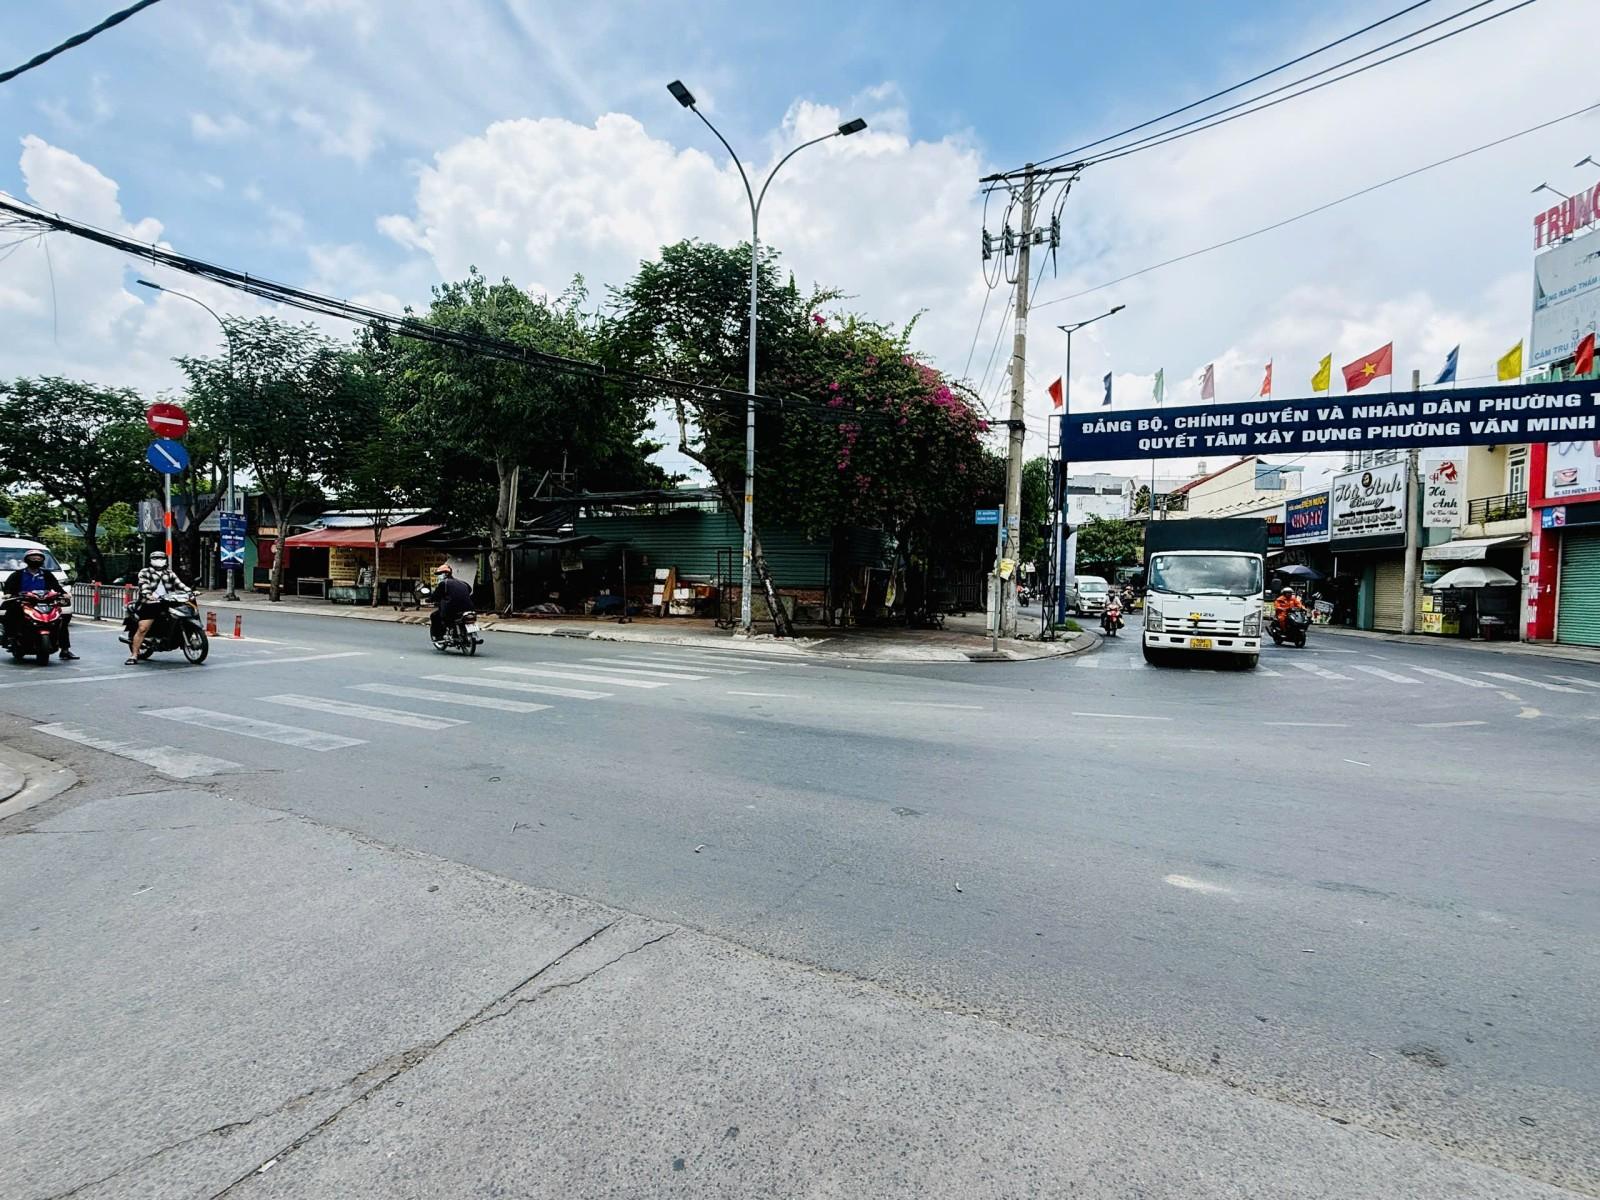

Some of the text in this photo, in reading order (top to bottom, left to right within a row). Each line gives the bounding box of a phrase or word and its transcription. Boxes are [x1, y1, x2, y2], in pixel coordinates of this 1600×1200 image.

[1082, 418, 1132, 434] ĐẢNG
[1138, 416, 1168, 432] BỘ,
[1174, 412, 1234, 429] CHÍNH
[1241, 407, 1309, 425] QUYỀN
[1317, 405, 1344, 421] VÀ
[1352, 401, 1415, 418] NHÂN
[1422, 398, 1471, 416] DÂN
[1479, 392, 1582, 412] PHƯỜNG
[1138, 415, 1596, 451] QUYẾT TÂM XÂY DỰNG PHƯỜNG VĂN MINH
[1432, 497, 1457, 508] Anh
[1423, 613, 1441, 623] KEM
